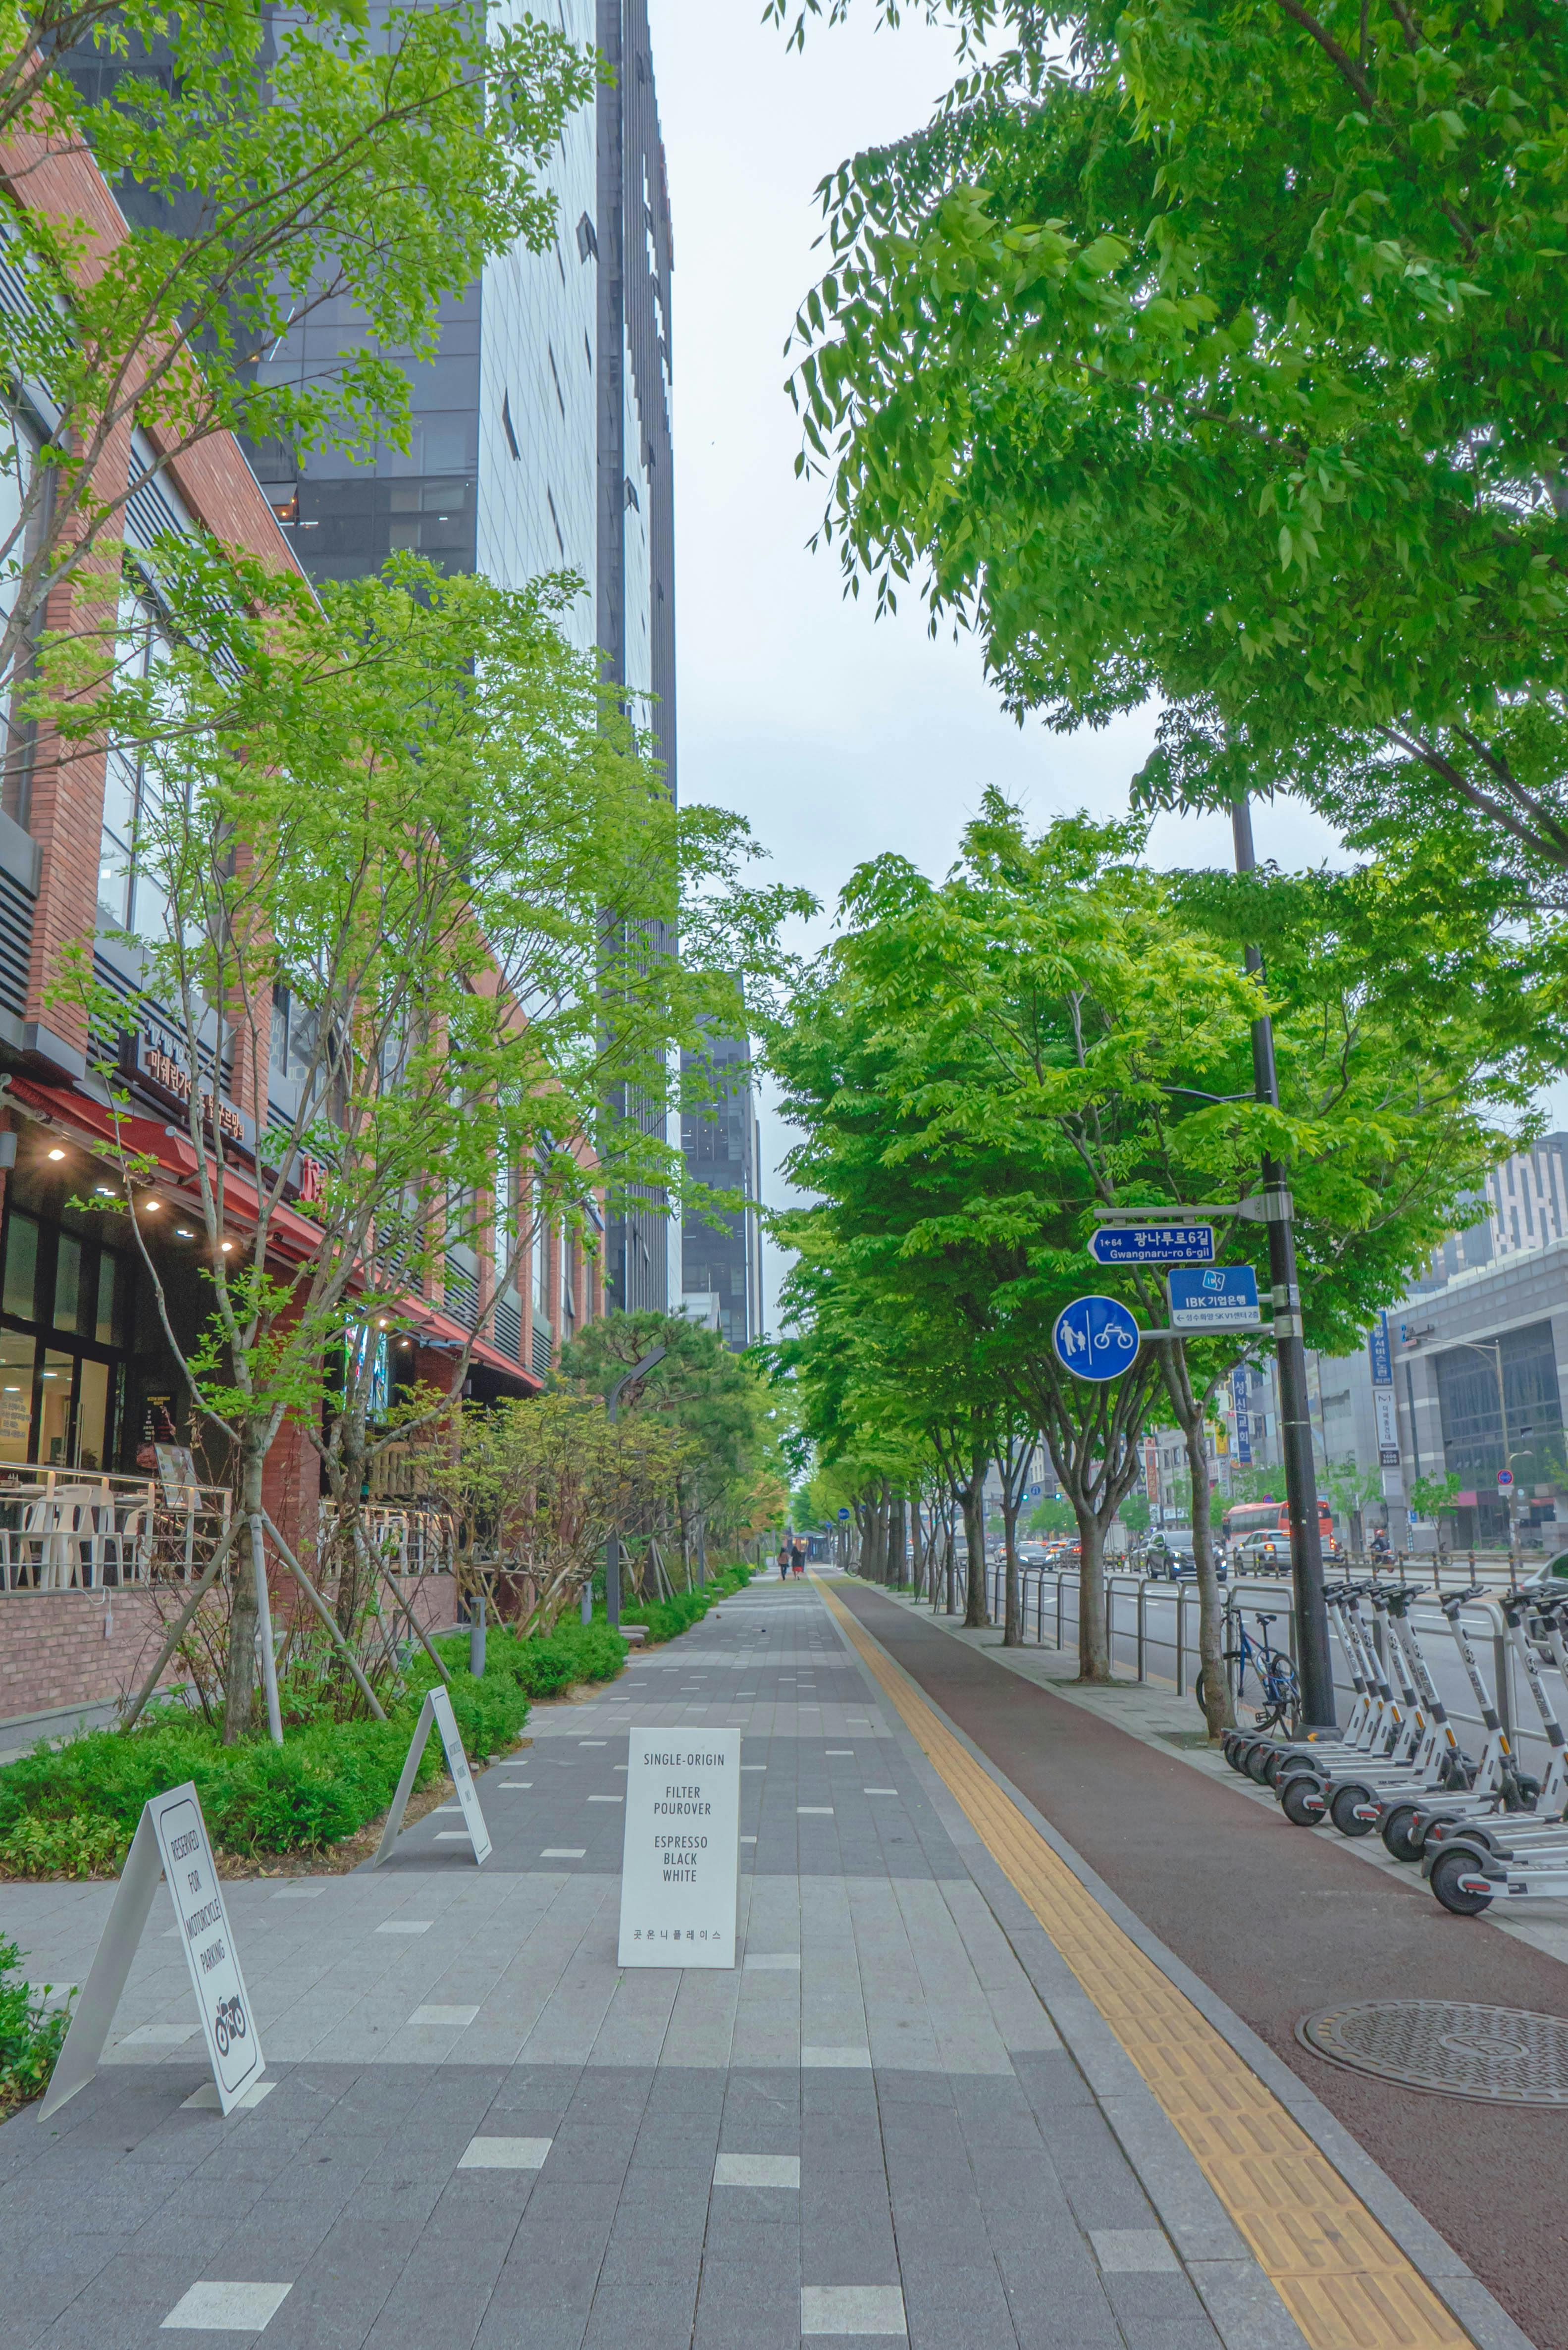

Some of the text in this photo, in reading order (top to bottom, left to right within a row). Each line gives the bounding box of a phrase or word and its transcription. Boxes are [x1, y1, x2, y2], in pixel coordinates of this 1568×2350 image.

[1134, 1230, 1208, 1247] 광나루로6길
[1110, 1248, 1209, 1260] Gwangnaru-ro 6-gil
[1235, 1381, 1249, 1445] 성신교회
[644, 1753, 725, 1766] SINGLE-ORIGIN
[666, 1786, 700, 1798] FILTER
[654, 1802, 711, 1815] POUROVER
[170, 1829, 200, 1862] RESERVED
[654, 1836, 708, 1848] ESPRESSO
[664, 1852, 697, 1865] BLACK
[188, 1870, 202, 1895] FOR
[663, 1870, 696, 1882] WHITE
[186, 1898, 221, 1941] MOTORCYCLE
[200, 1938, 225, 1975] PARKING
